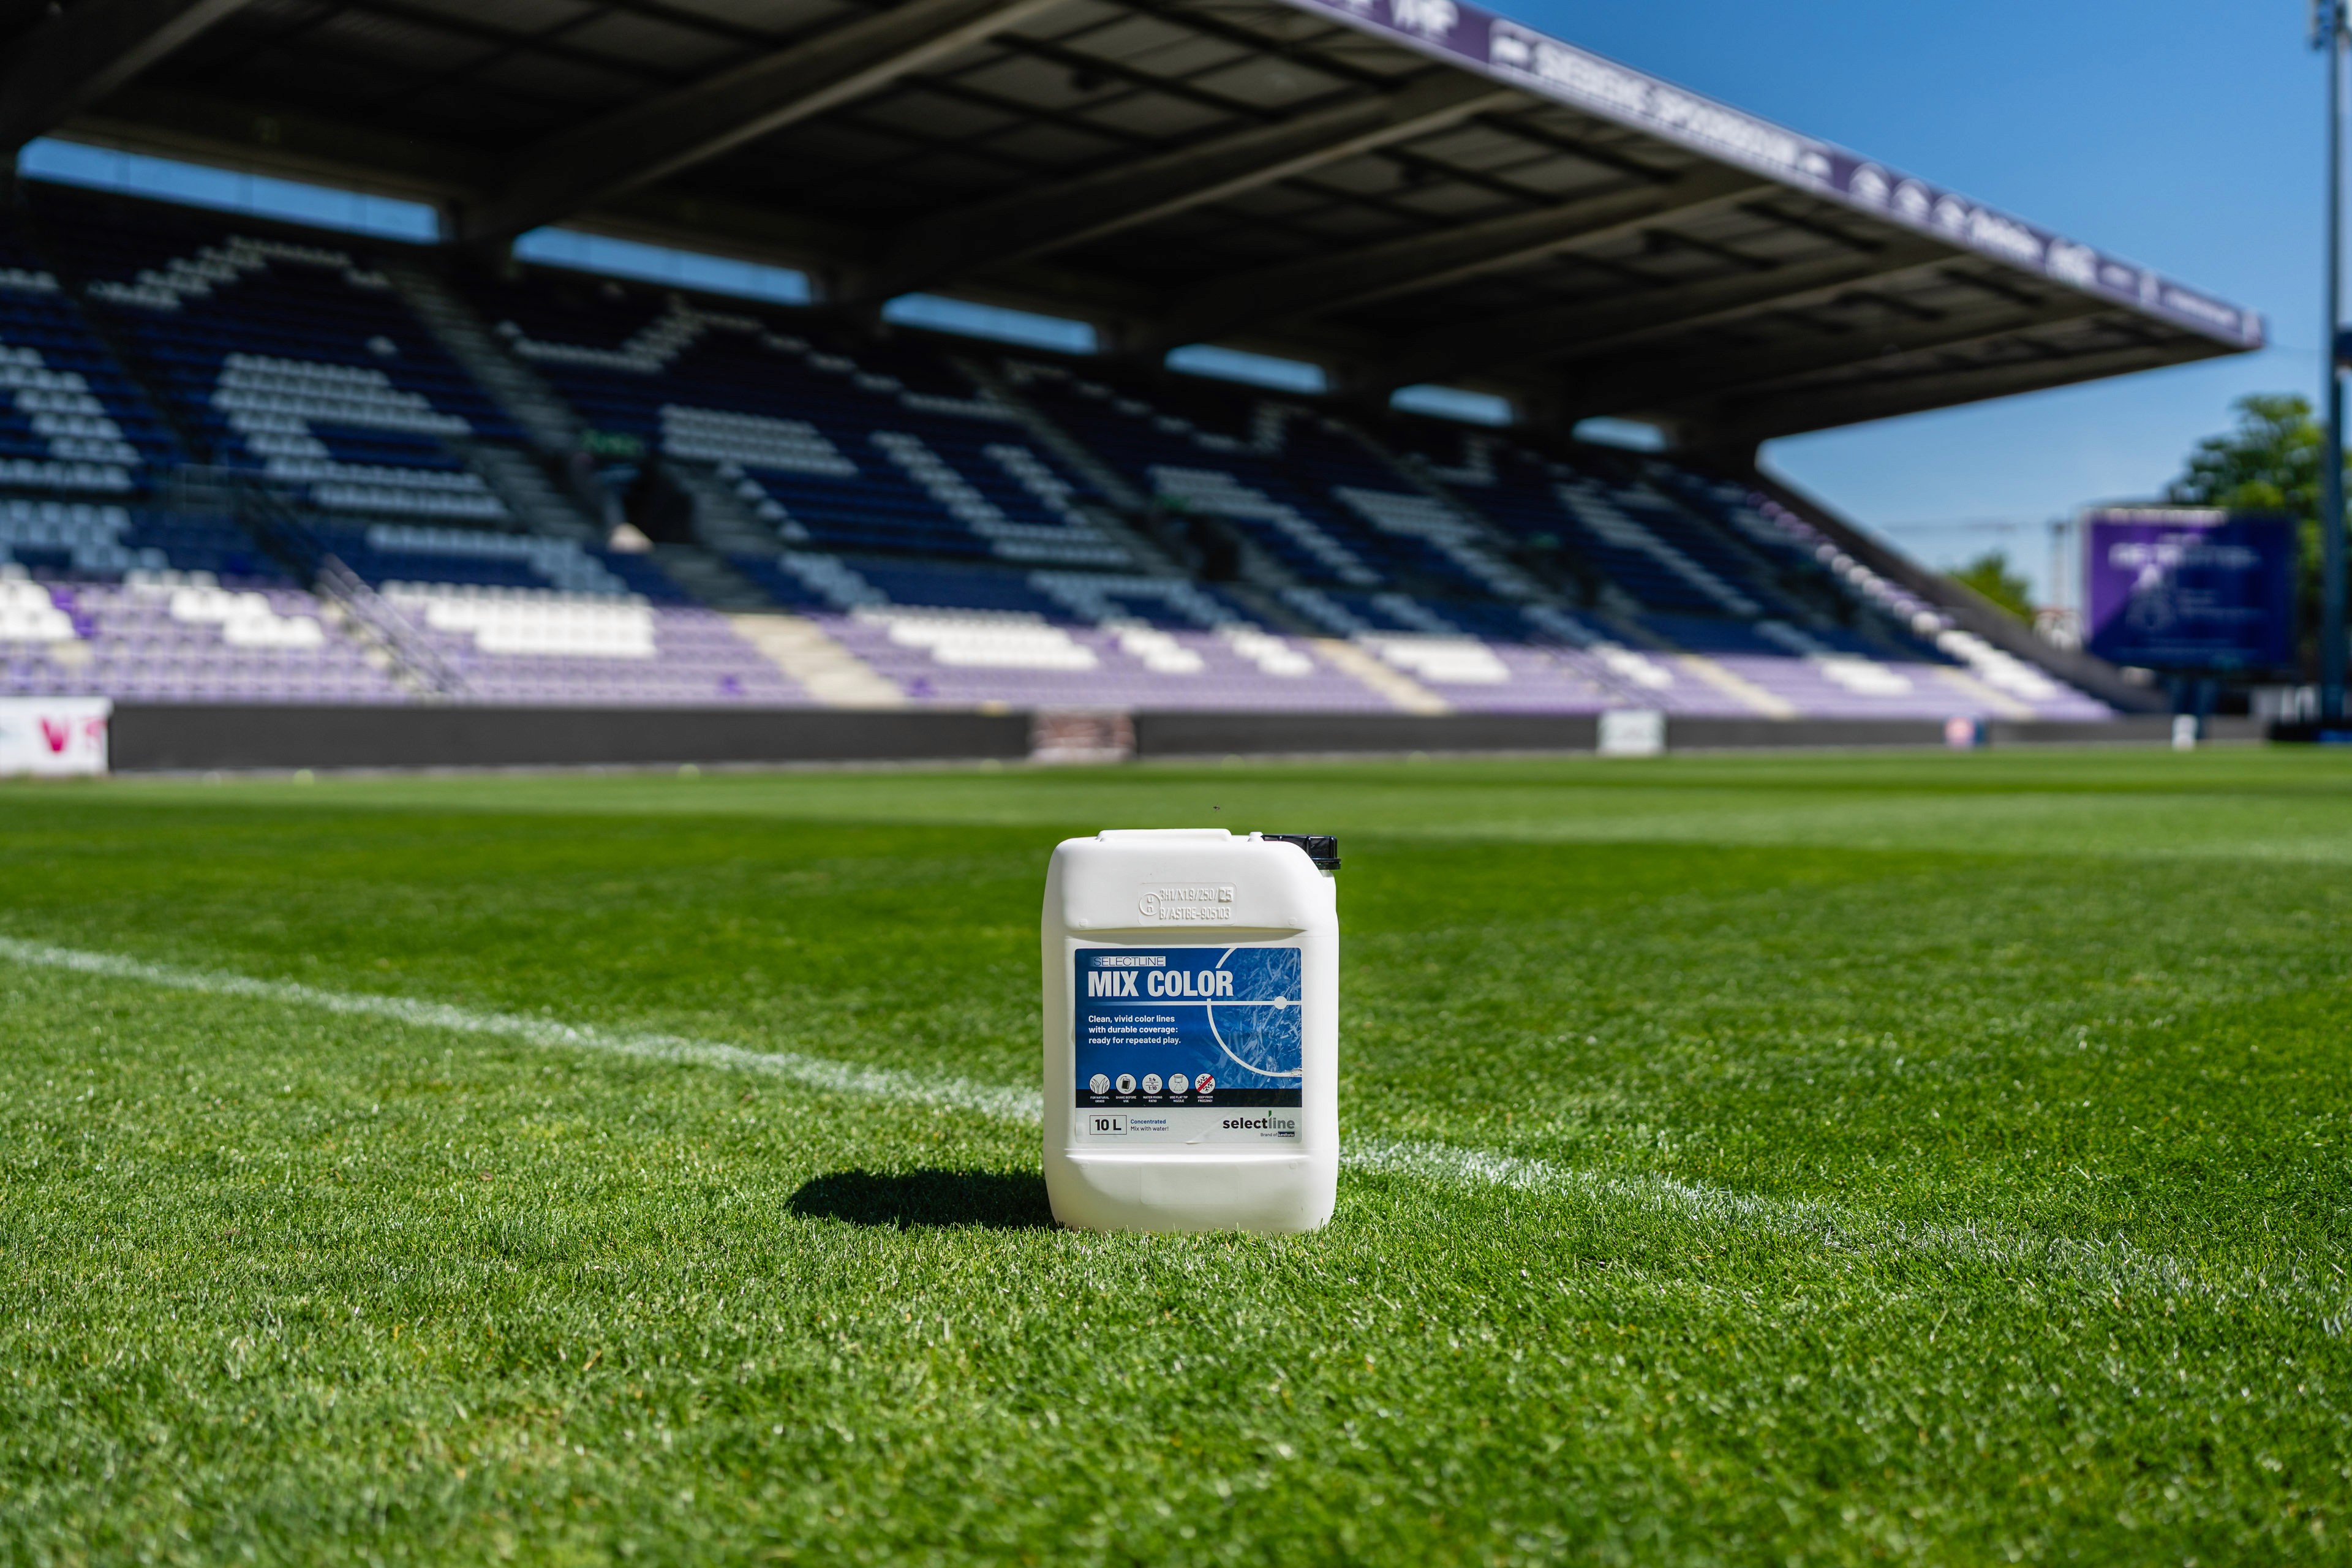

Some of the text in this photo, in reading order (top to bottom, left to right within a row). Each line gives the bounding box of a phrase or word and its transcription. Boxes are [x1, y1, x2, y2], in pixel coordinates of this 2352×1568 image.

[1093, 957, 1164, 966] SELECTLINE
[1088, 970, 1234, 997] MIX COLOR
[1088, 1015, 1112, 1023] Clean,
[1088, 1037, 1110, 1046] ready
[1125, 1036, 1161, 1045] repeated
[1163, 1036, 1181, 1045] play.
[1095, 1119, 1121, 1131] 10 L
[1223, 1110, 1295, 1129] selectline
